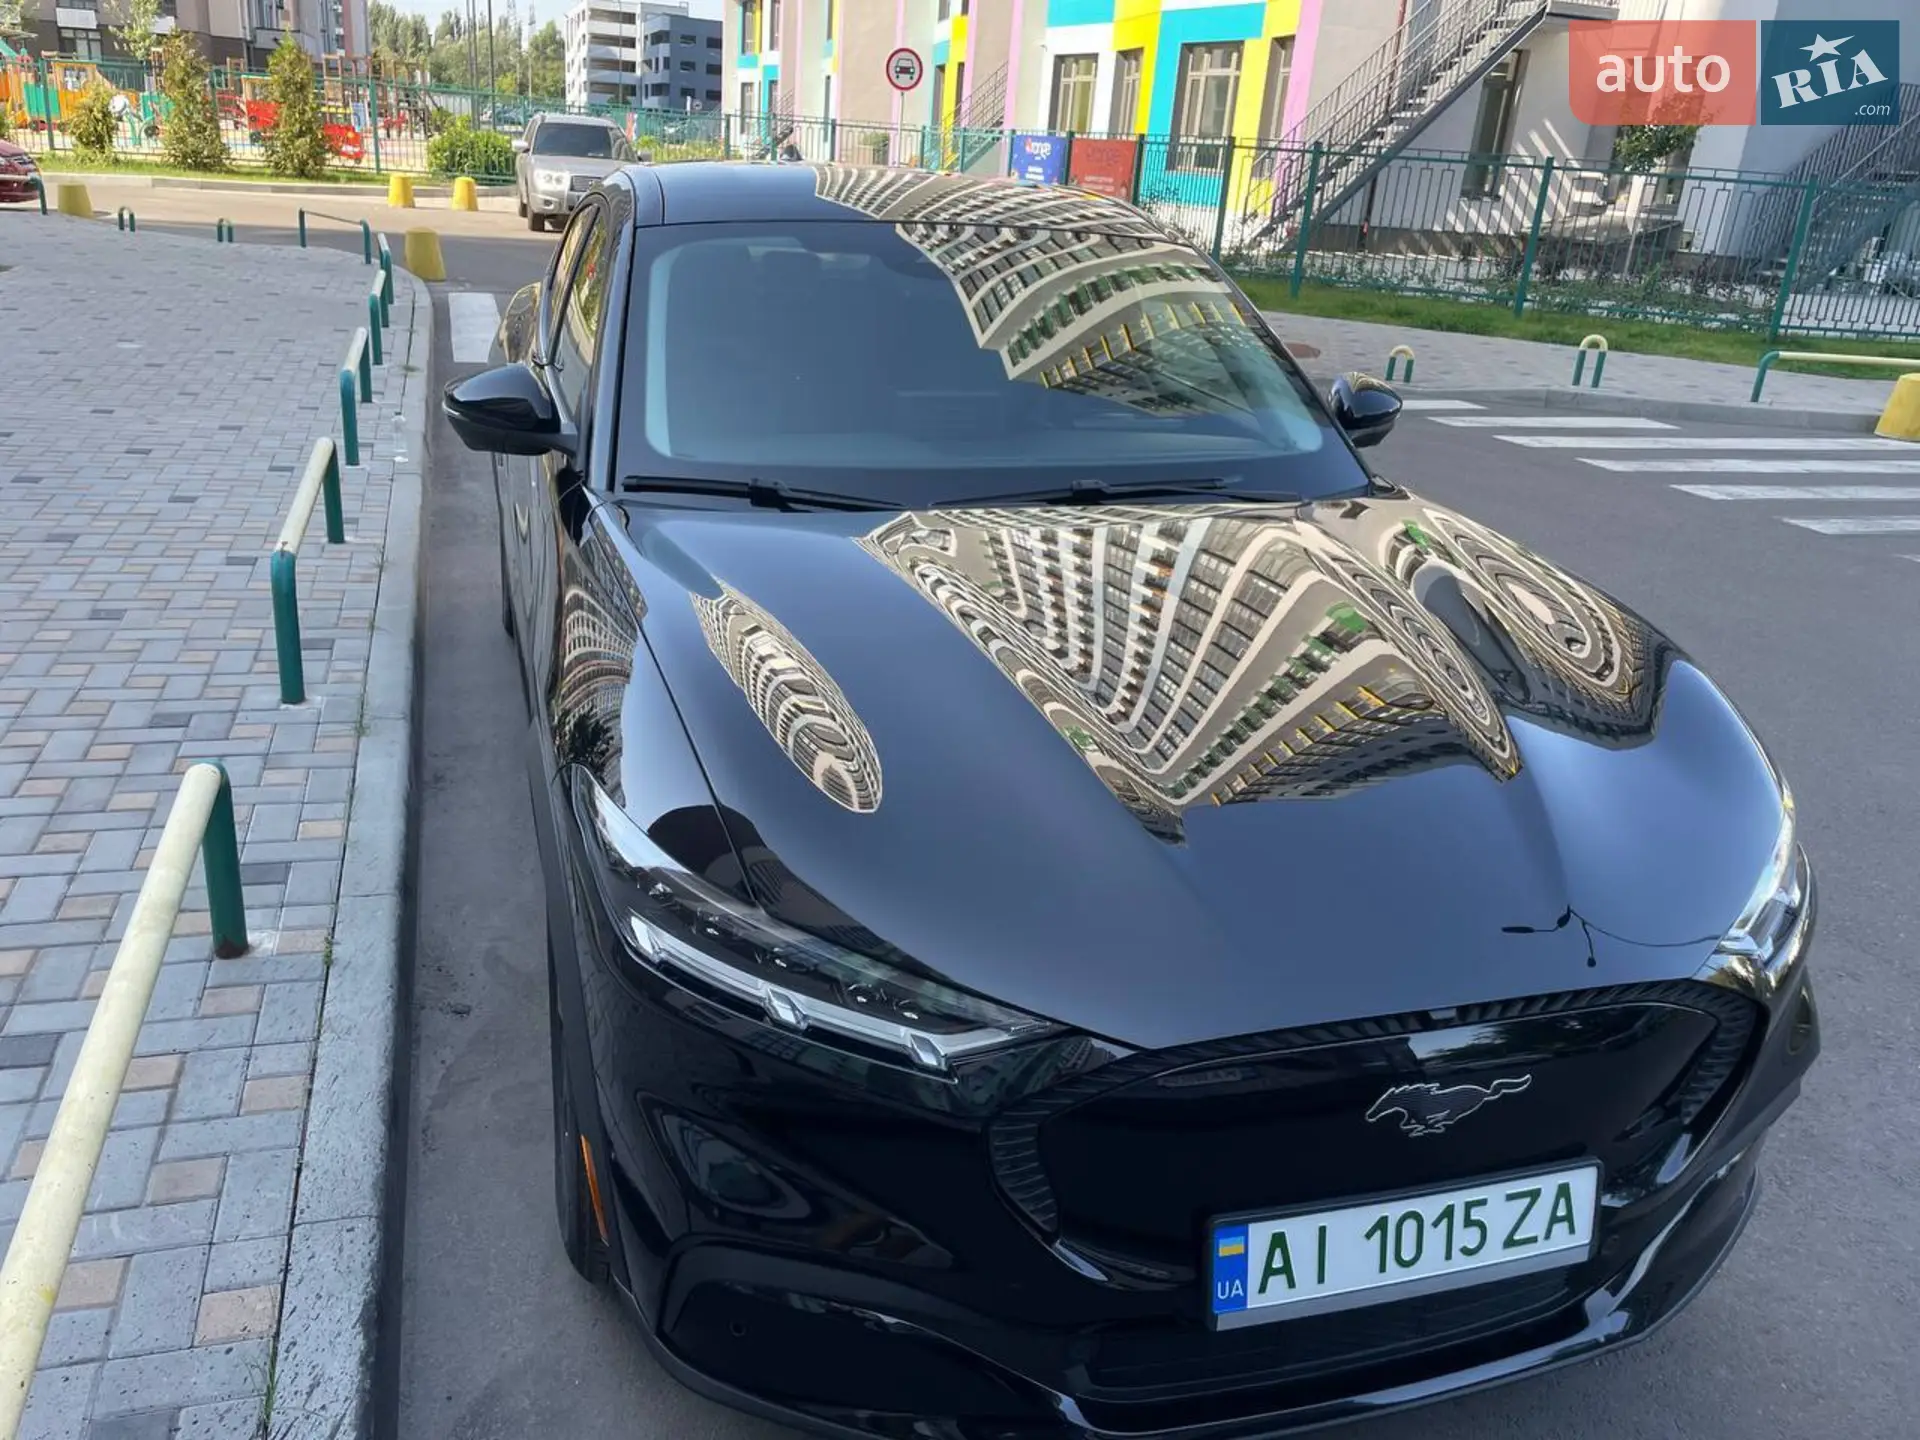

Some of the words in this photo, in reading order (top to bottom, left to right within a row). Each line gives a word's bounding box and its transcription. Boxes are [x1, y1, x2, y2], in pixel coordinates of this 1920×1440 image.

[1258, 1225, 1327, 1294] AI
[1364, 1198, 1489, 1274] 1015
[1503, 1181, 1576, 1249] ZA
[1217, 1279, 1244, 1300] UA
